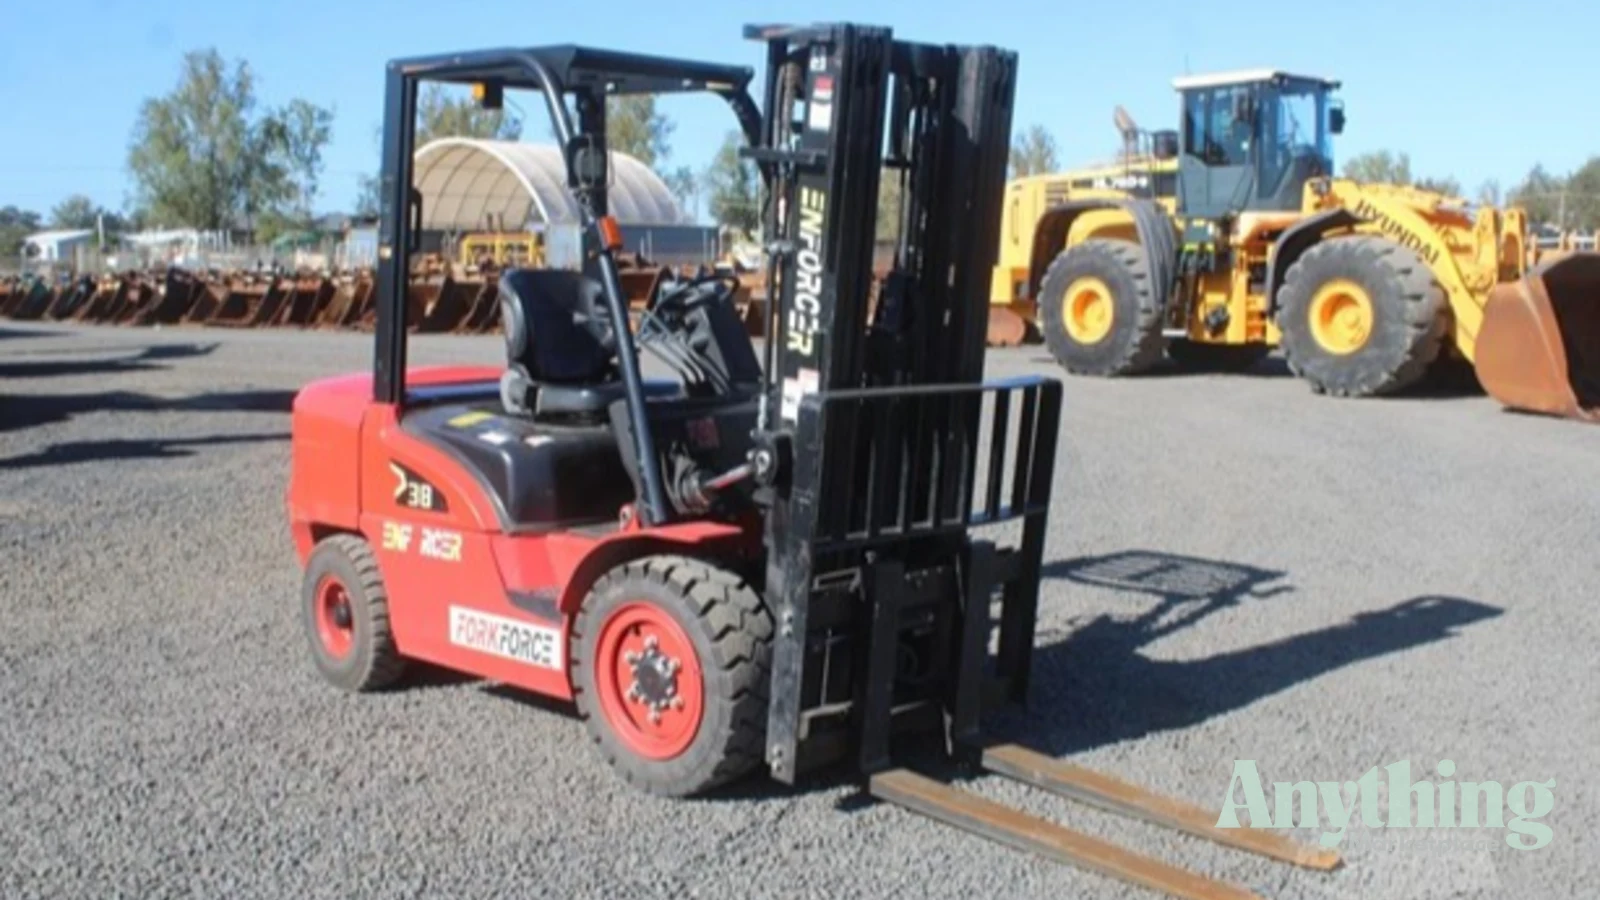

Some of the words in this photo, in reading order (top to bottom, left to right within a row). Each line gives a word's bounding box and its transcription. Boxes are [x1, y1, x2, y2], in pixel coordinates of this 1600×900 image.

[1355, 199, 1440, 265] HYUNDAI
[787, 186, 825, 356] ENFORCER
[457, 613, 554, 663] FORKFORCE
